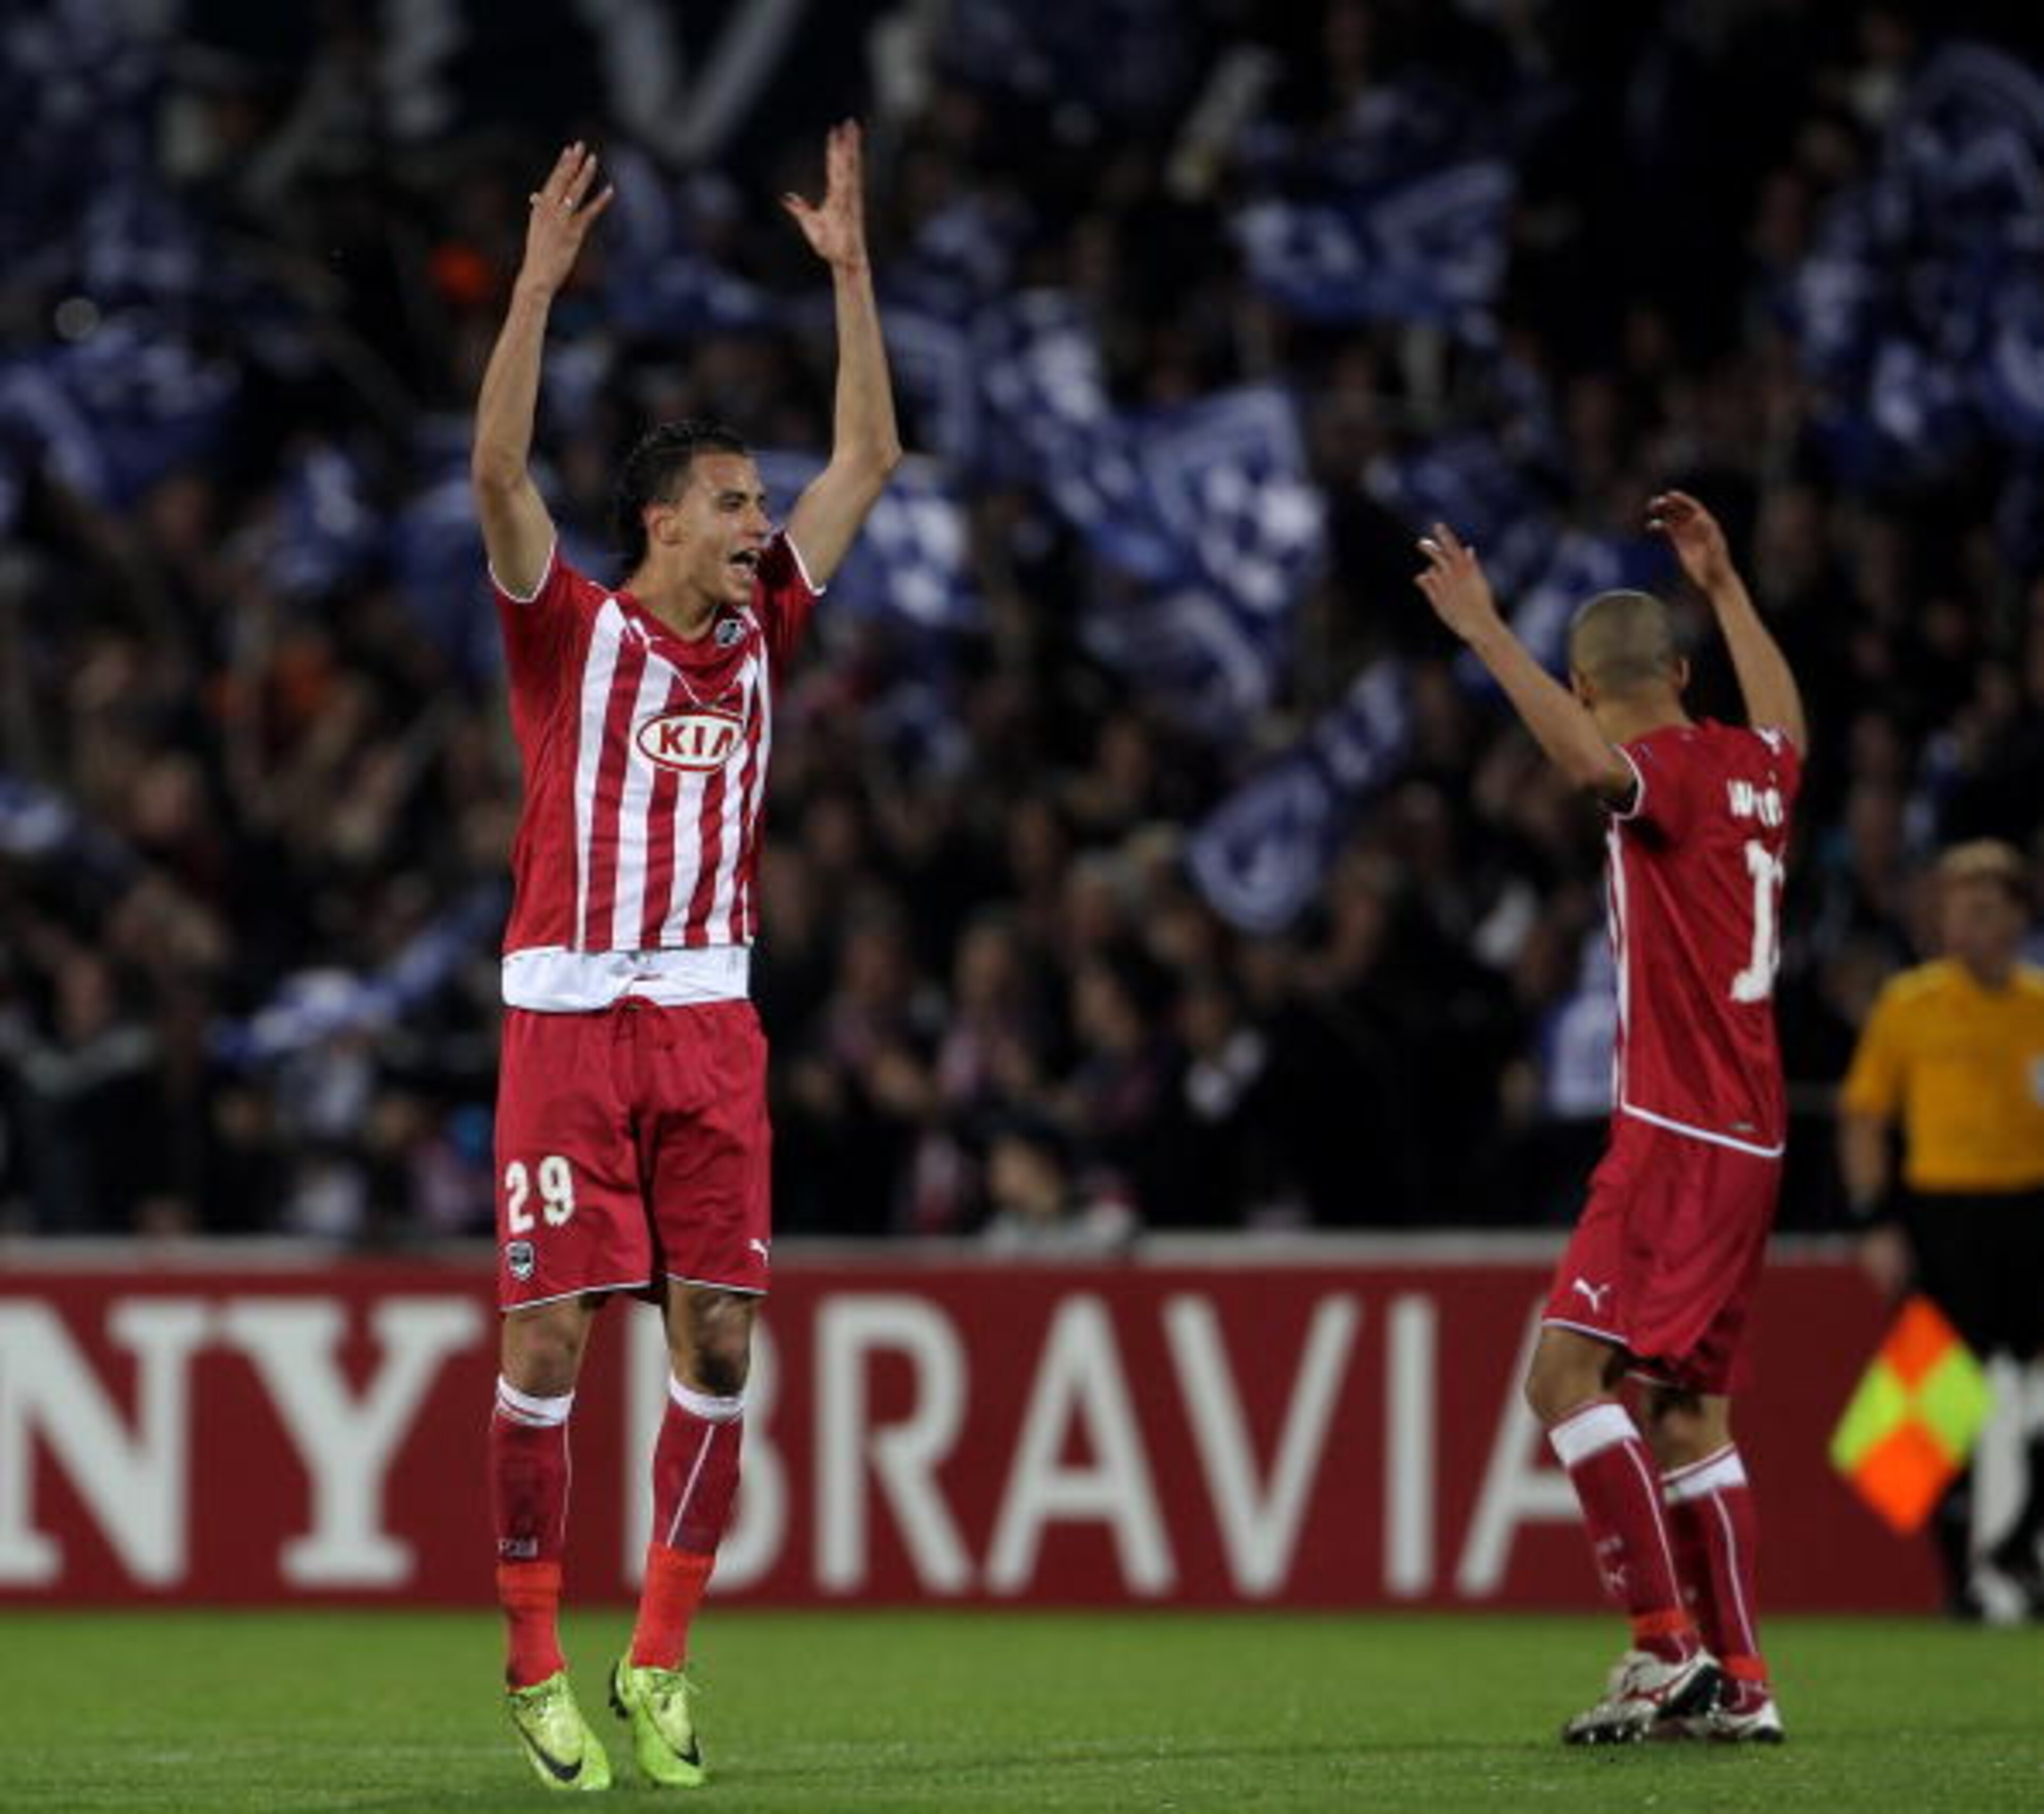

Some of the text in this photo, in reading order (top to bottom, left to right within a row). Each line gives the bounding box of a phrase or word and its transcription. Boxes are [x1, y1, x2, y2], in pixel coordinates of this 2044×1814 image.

[660, 722, 734, 756] KIA
[505, 1155, 576, 1233] 29
[0, 1296, 485, 1587] NY
